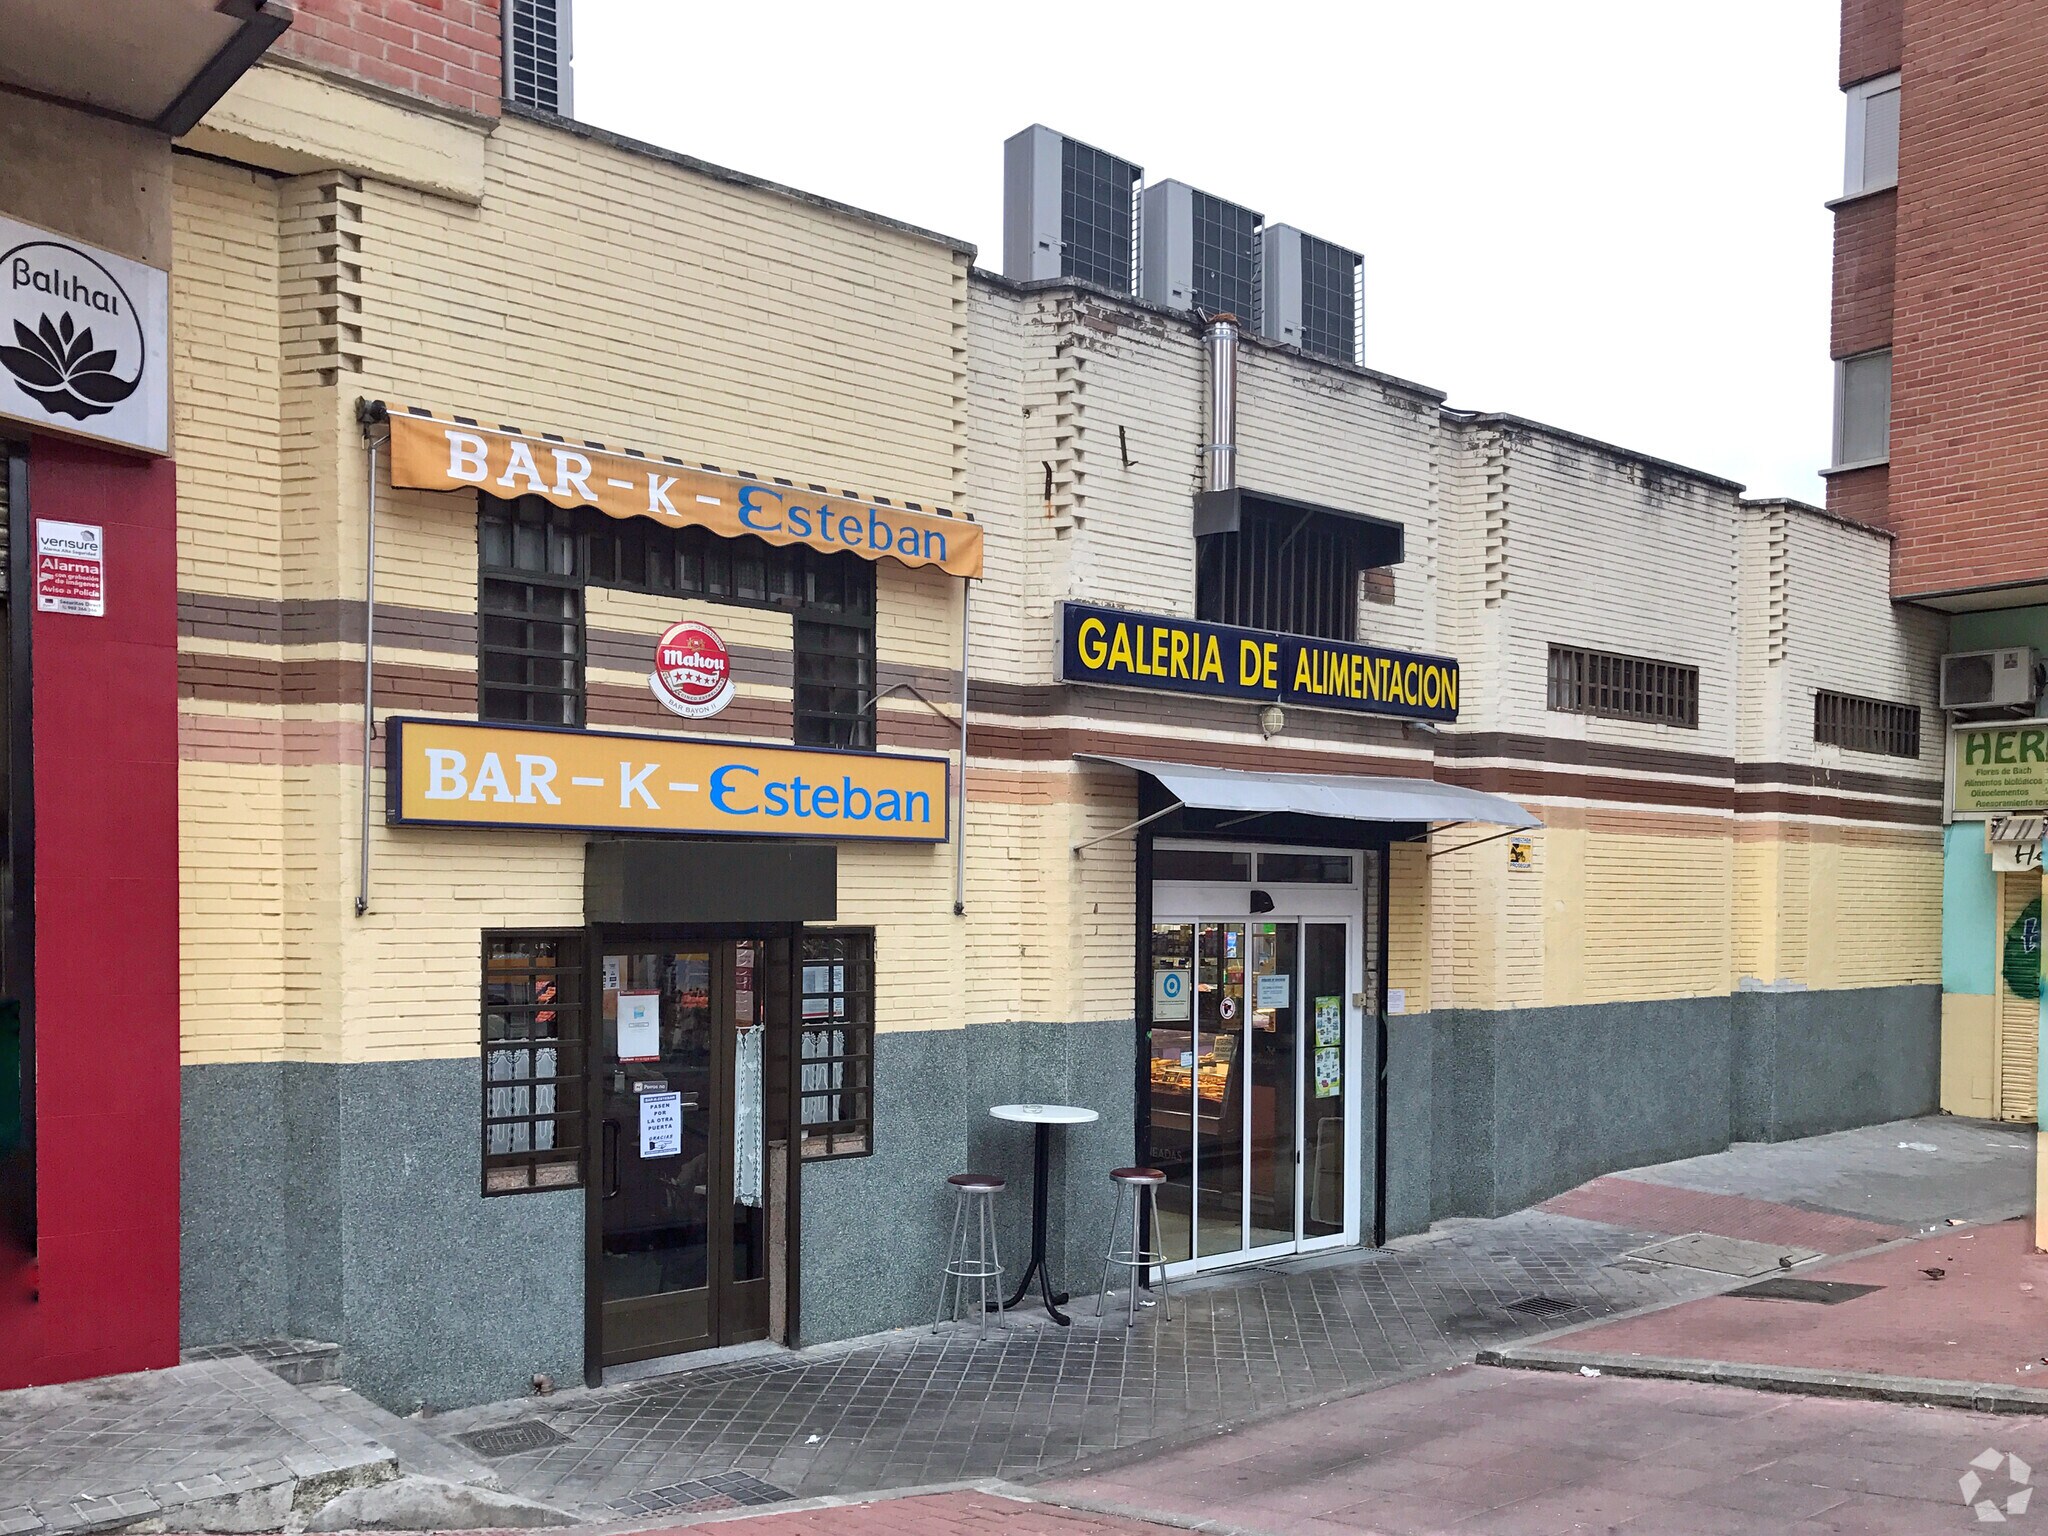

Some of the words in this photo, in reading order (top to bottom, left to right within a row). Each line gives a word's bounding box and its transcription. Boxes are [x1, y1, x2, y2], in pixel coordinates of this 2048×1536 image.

[444, 429, 598, 501] BAR
[646, 472, 682, 517] K
[738, 485, 947, 562] Esteban
[40, 537, 98, 551] verisure
[40, 558, 99, 575] Alarma
[65, 579, 100, 588] imágenes
[41, 585, 65, 594] Aviso
[73, 588, 100, 598] Policía
[662, 649, 724, 670] Mahou
[1077, 617, 1225, 684] GALERIA
[1239, 639, 1278, 690] DE
[1293, 646, 1457, 711] ALIMENTACION
[668, 699, 684, 710] BAR
[685, 706, 710, 714] BAYON
[1966, 730, 2048, 765] HER
[1976, 768, 2000, 776] Flores
[2013, 766, 2032, 775] Bach
[424, 748, 561, 805] BAR
[619, 761, 661, 810] K
[709, 764, 931, 823] Esteban
[1964, 779, 2002, 787] Alimentos
[1976, 799, 2034, 808] Asesoramiento
